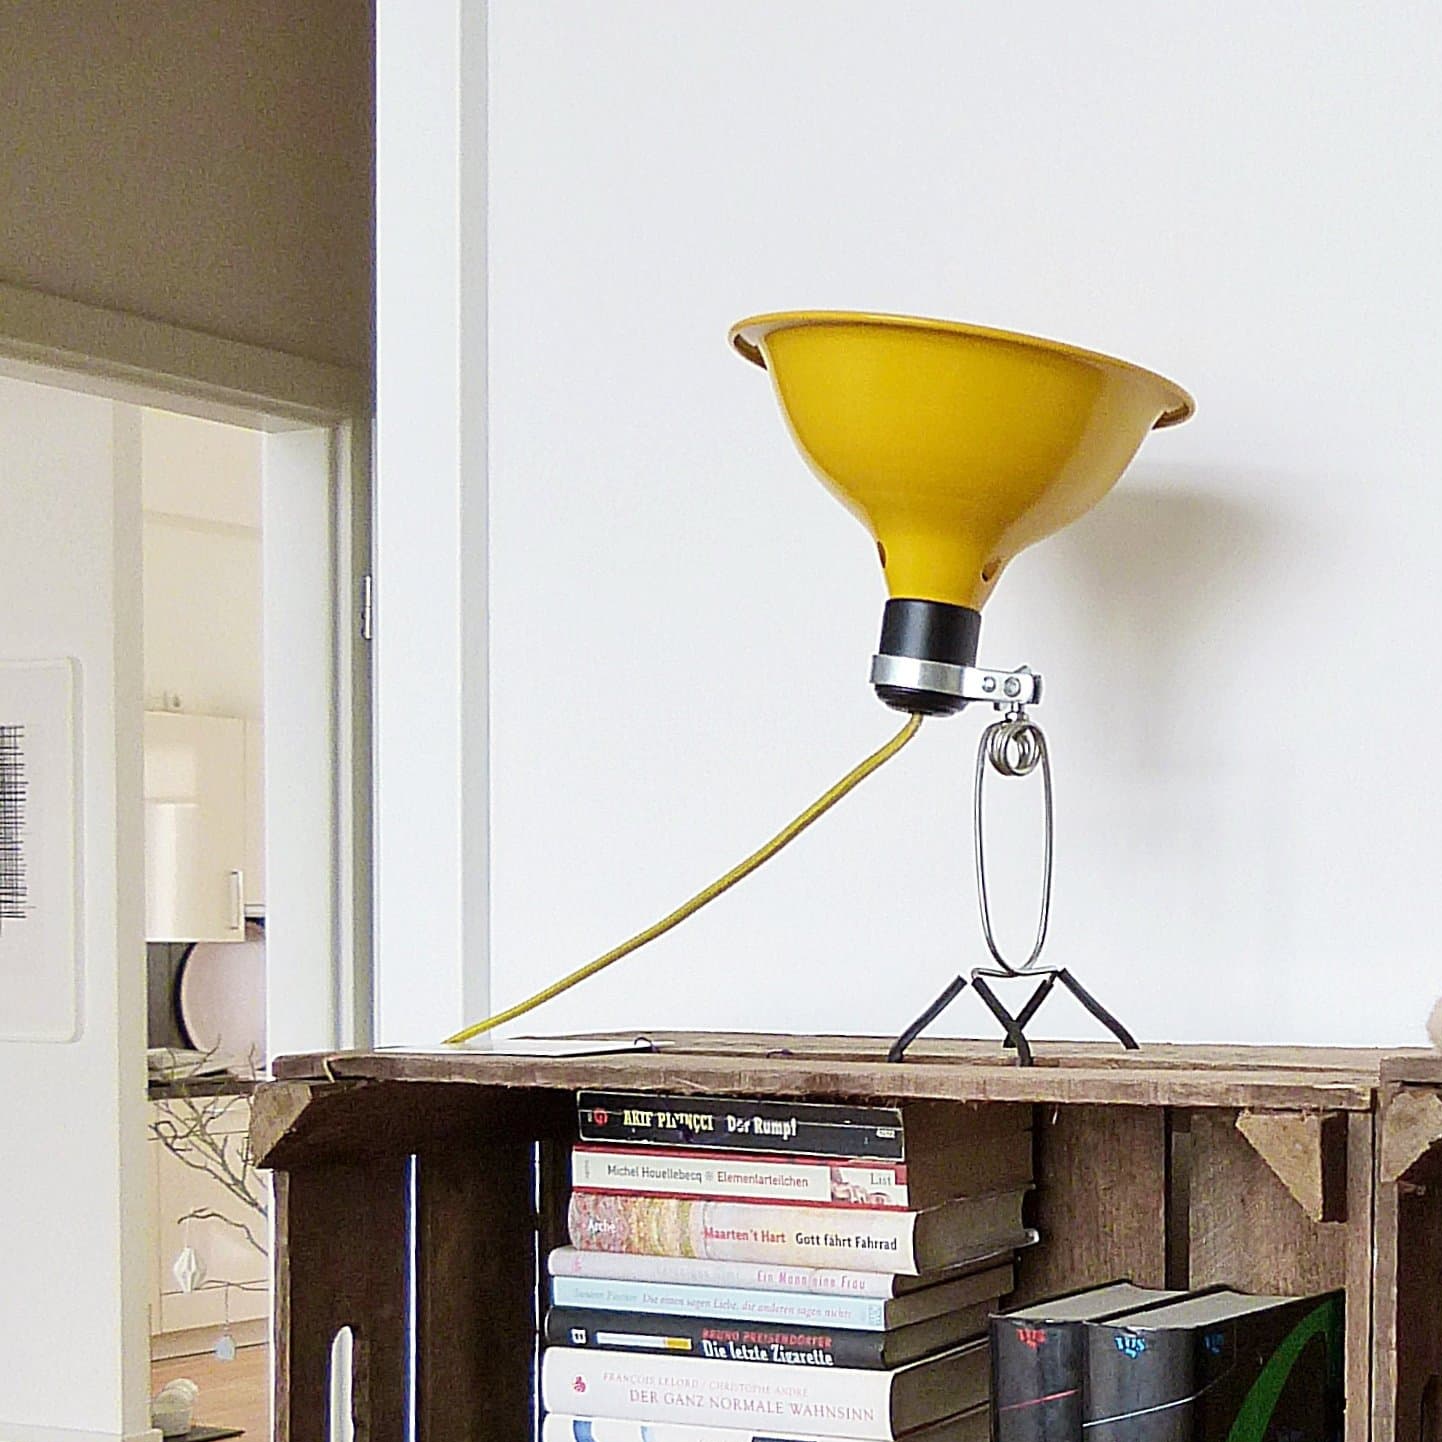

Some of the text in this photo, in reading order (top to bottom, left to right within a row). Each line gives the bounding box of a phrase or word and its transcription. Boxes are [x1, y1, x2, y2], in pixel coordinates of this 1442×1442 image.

[753, 1118, 797, 1140] Rumpf
[607, 1164, 639, 1179] Michel
[717, 1171, 808, 1188] Elementarteilchen
[704, 1228, 786, 1243] Maarten Hart
[795, 1233, 898, 1251] Gott Fahrrad
[841, 1277, 865, 1291] Frau
[702, 1341, 835, 1367] Die letzte Zigarette
[1114, 1336, 1146, 1359] vgs
[629, 1389, 875, 1421] DER GANZ NORMALE WAHNSINN
